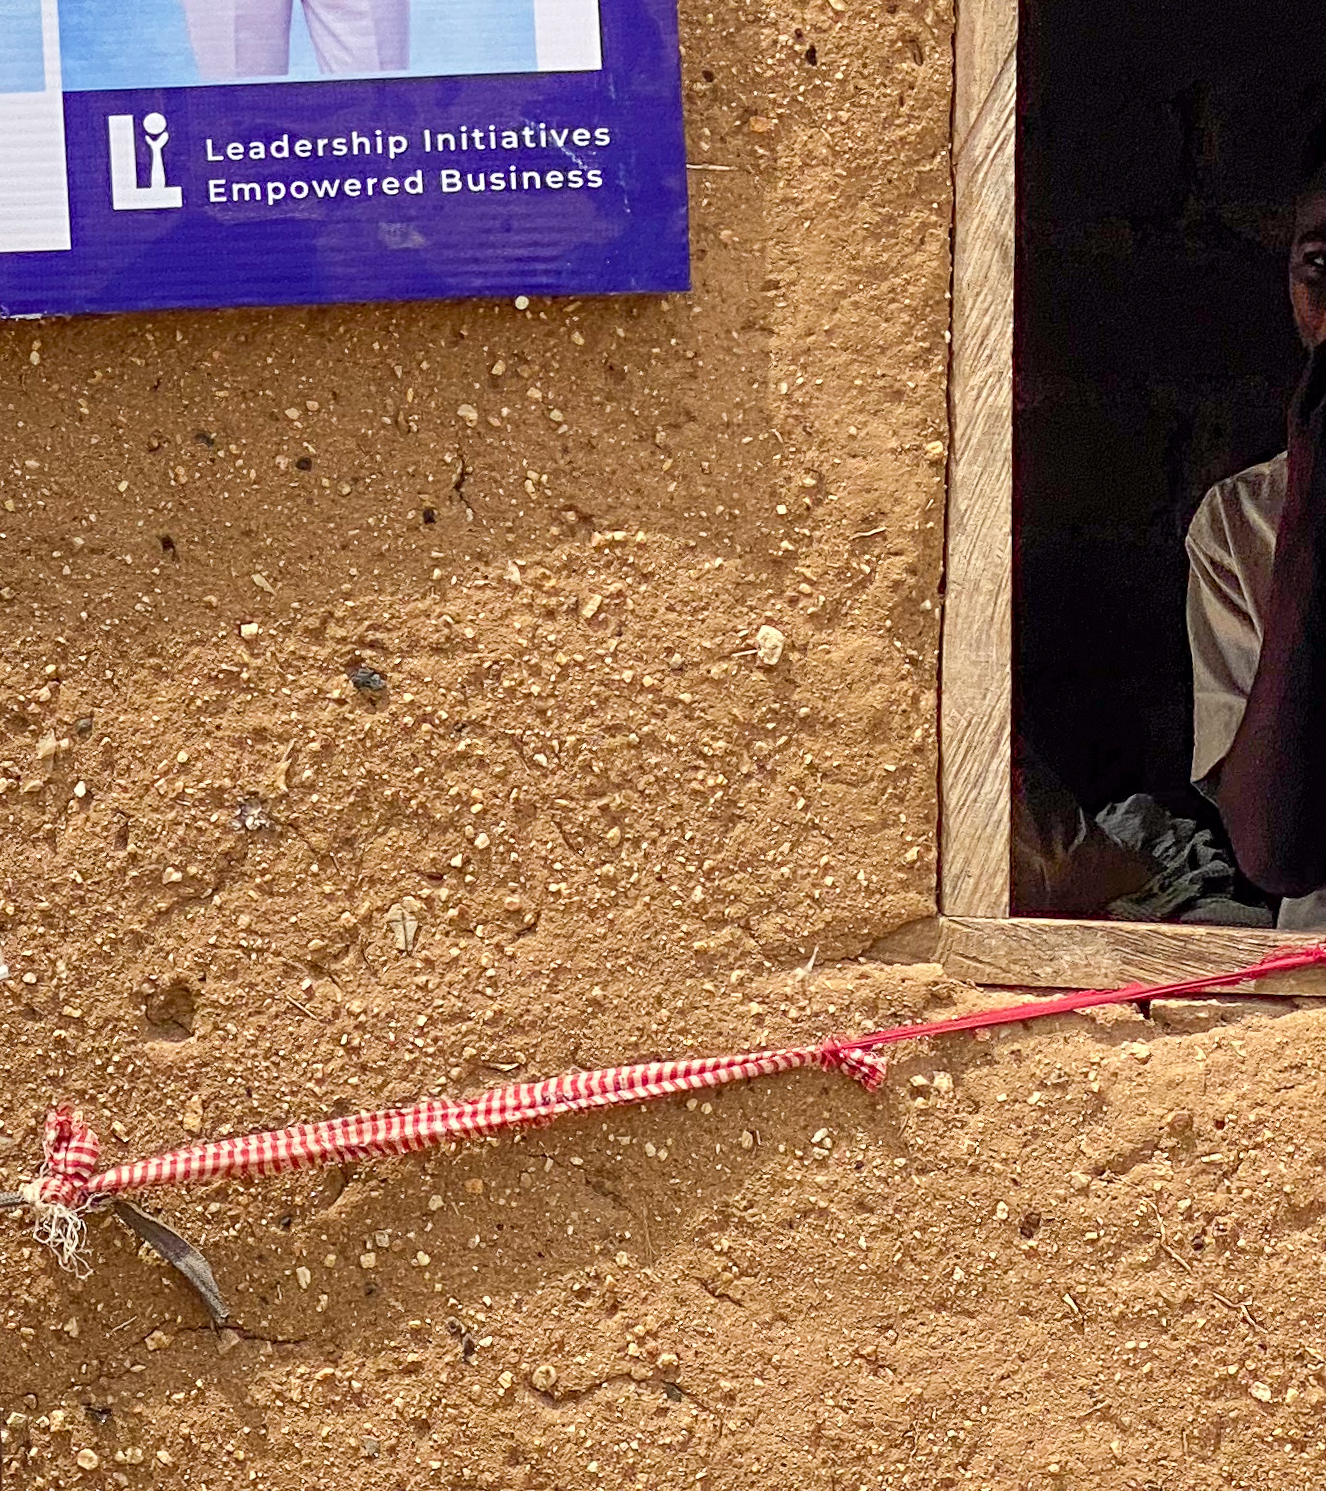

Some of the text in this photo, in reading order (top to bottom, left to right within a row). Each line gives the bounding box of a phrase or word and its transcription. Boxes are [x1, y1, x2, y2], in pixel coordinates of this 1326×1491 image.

[205, 122, 611, 161] Leadership Initiatives
[208, 164, 603, 206] Empowered Business
